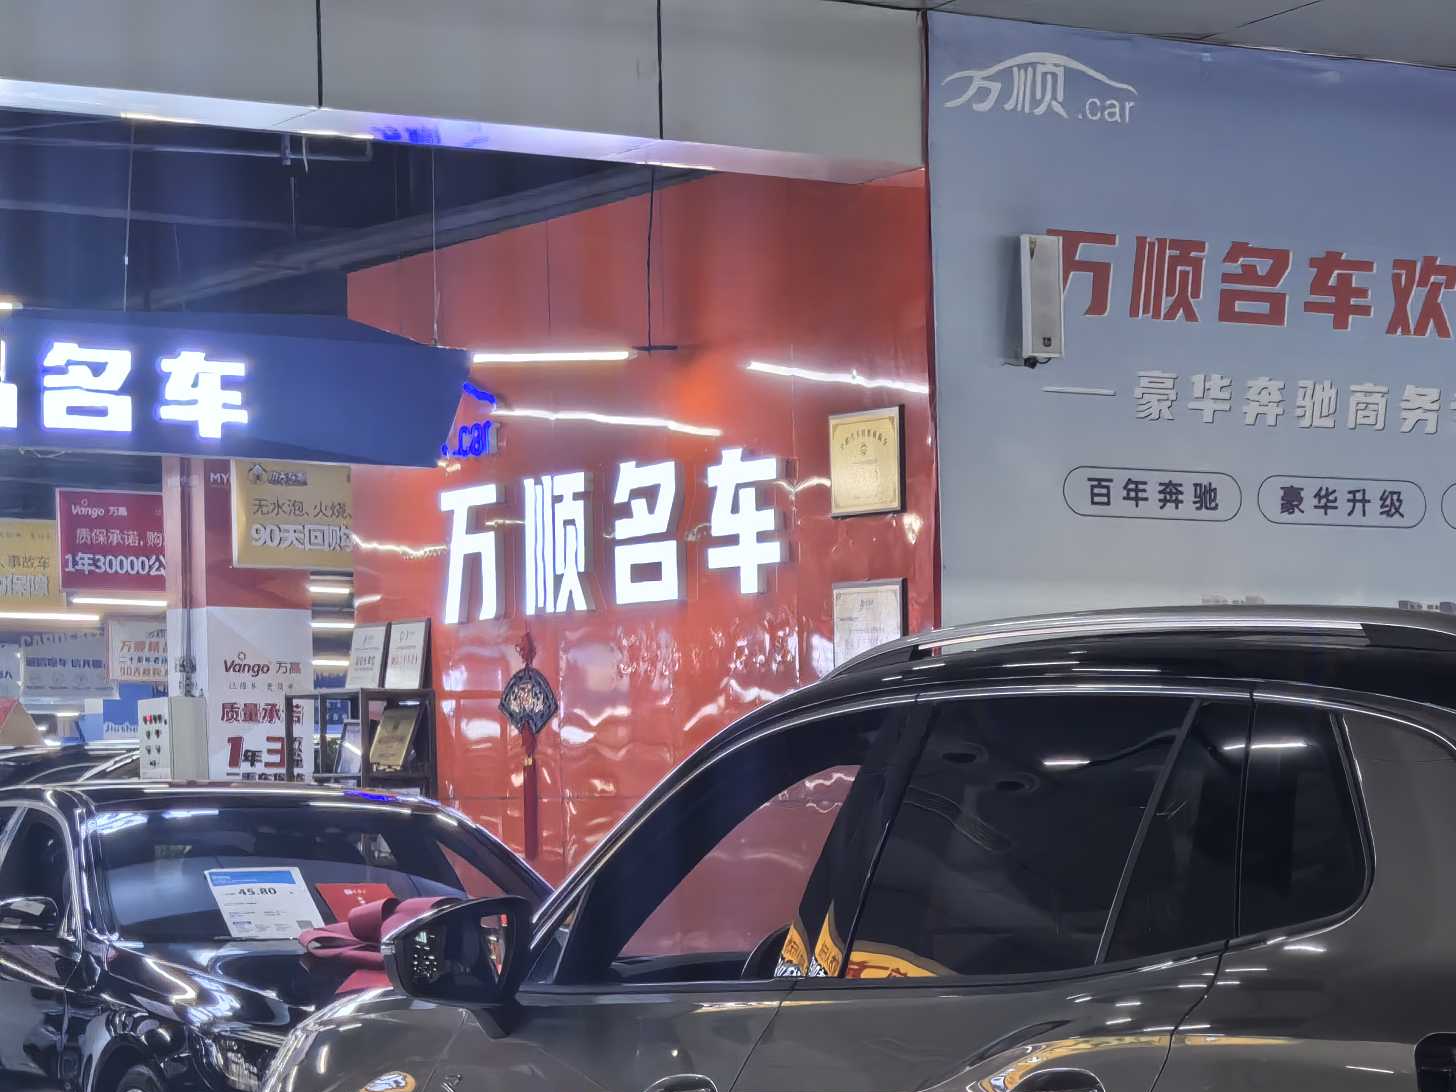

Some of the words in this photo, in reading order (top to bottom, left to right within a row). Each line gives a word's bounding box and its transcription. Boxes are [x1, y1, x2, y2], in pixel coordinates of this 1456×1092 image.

[0, 340, 249, 440] 名车
[1087, 476, 1220, 512] 百年奔驰
[1278, 484, 1406, 520] 豪华升级
[440, 448, 782, 625] 万顺名车
[223, 658, 271, 679] Vango
